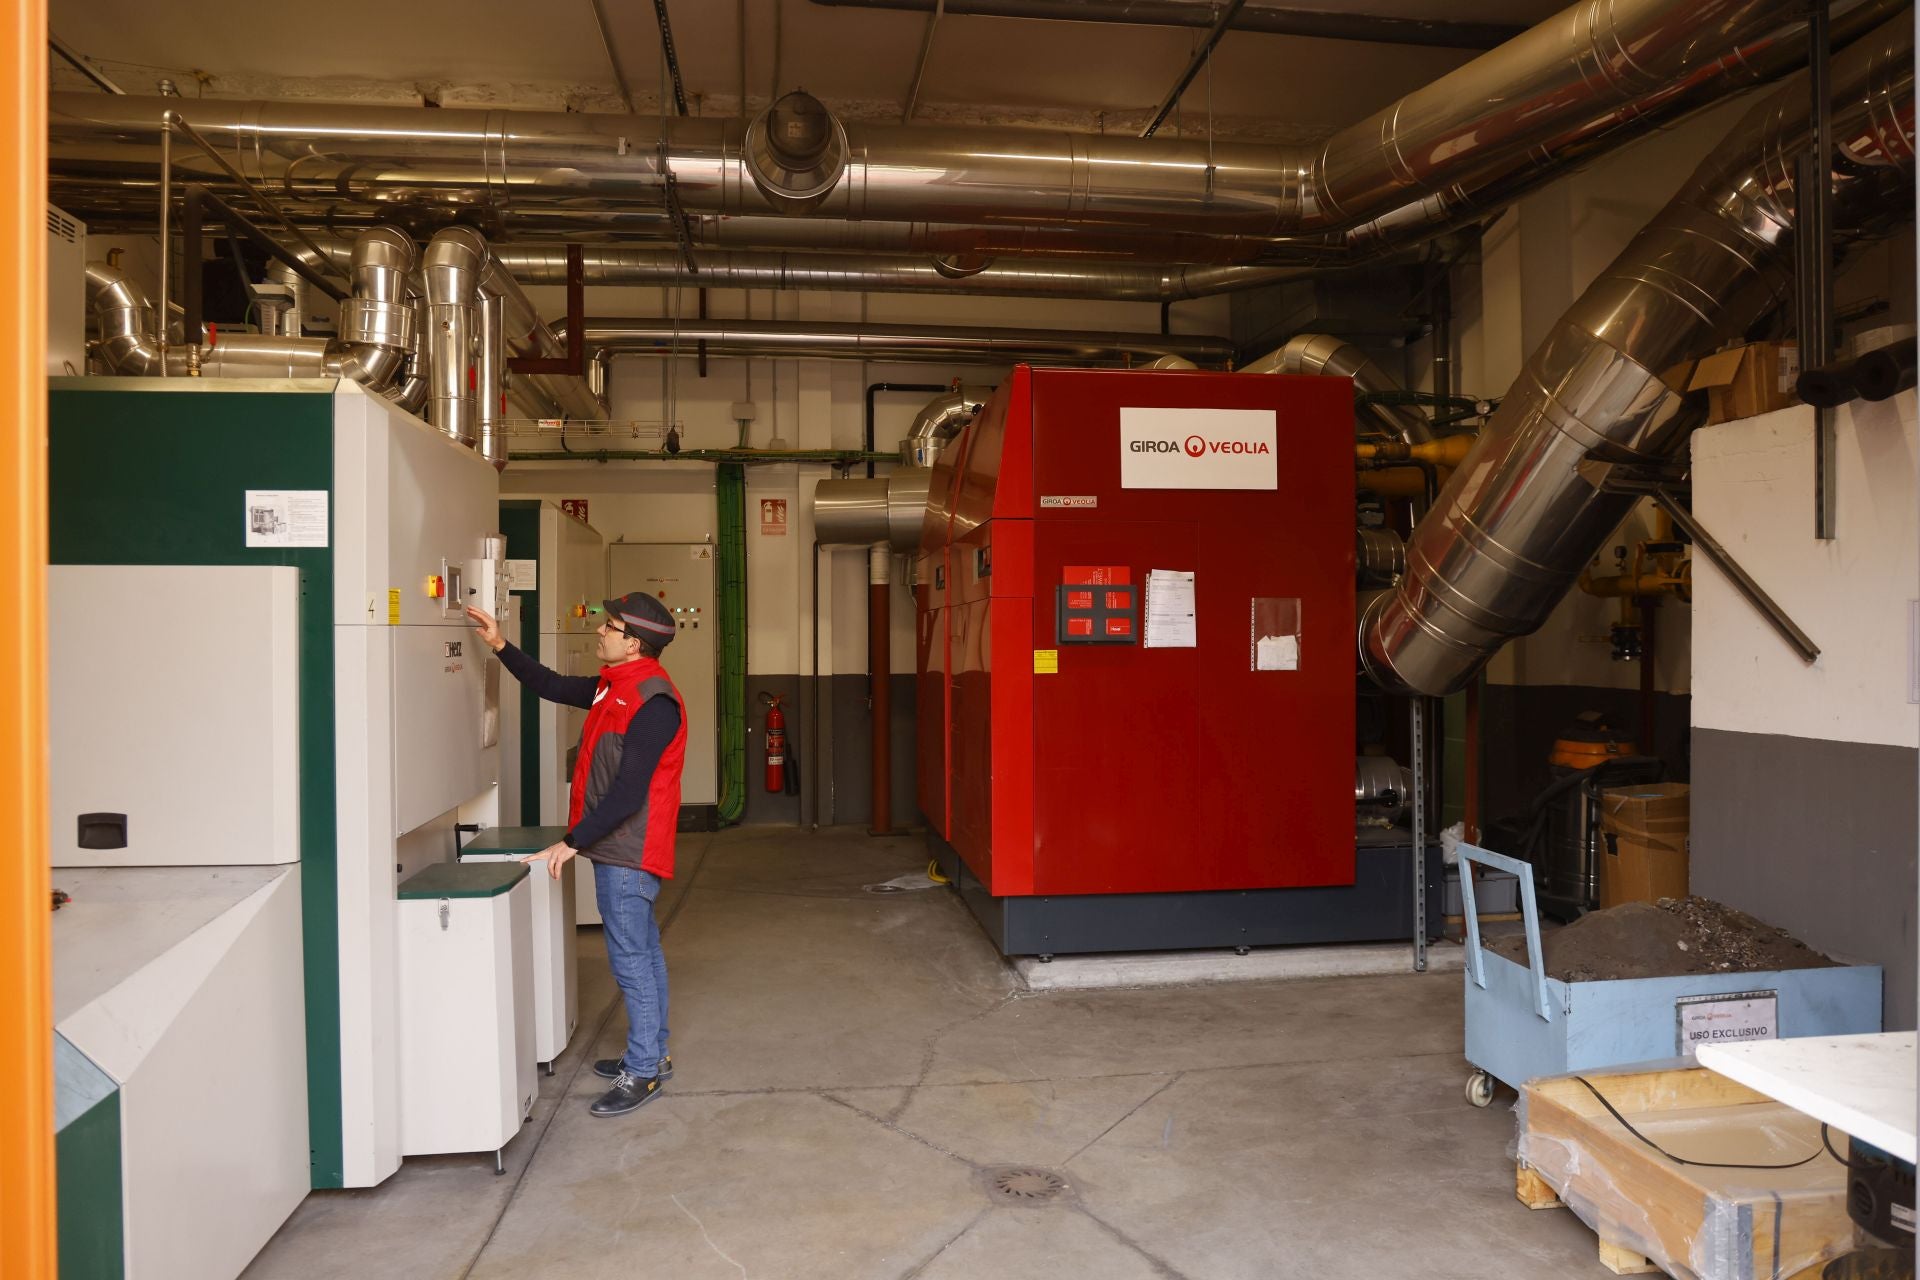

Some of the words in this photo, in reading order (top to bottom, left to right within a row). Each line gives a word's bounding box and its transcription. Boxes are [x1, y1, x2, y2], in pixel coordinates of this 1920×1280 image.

[1130, 440, 1180, 453] GIROA
[1208, 441, 1270, 454] VEOLIA
[368, 599, 375, 619] 4
[1689, 1030, 1710, 1040] USO
[1712, 1026, 1768, 1039] EXCLUSIVO
